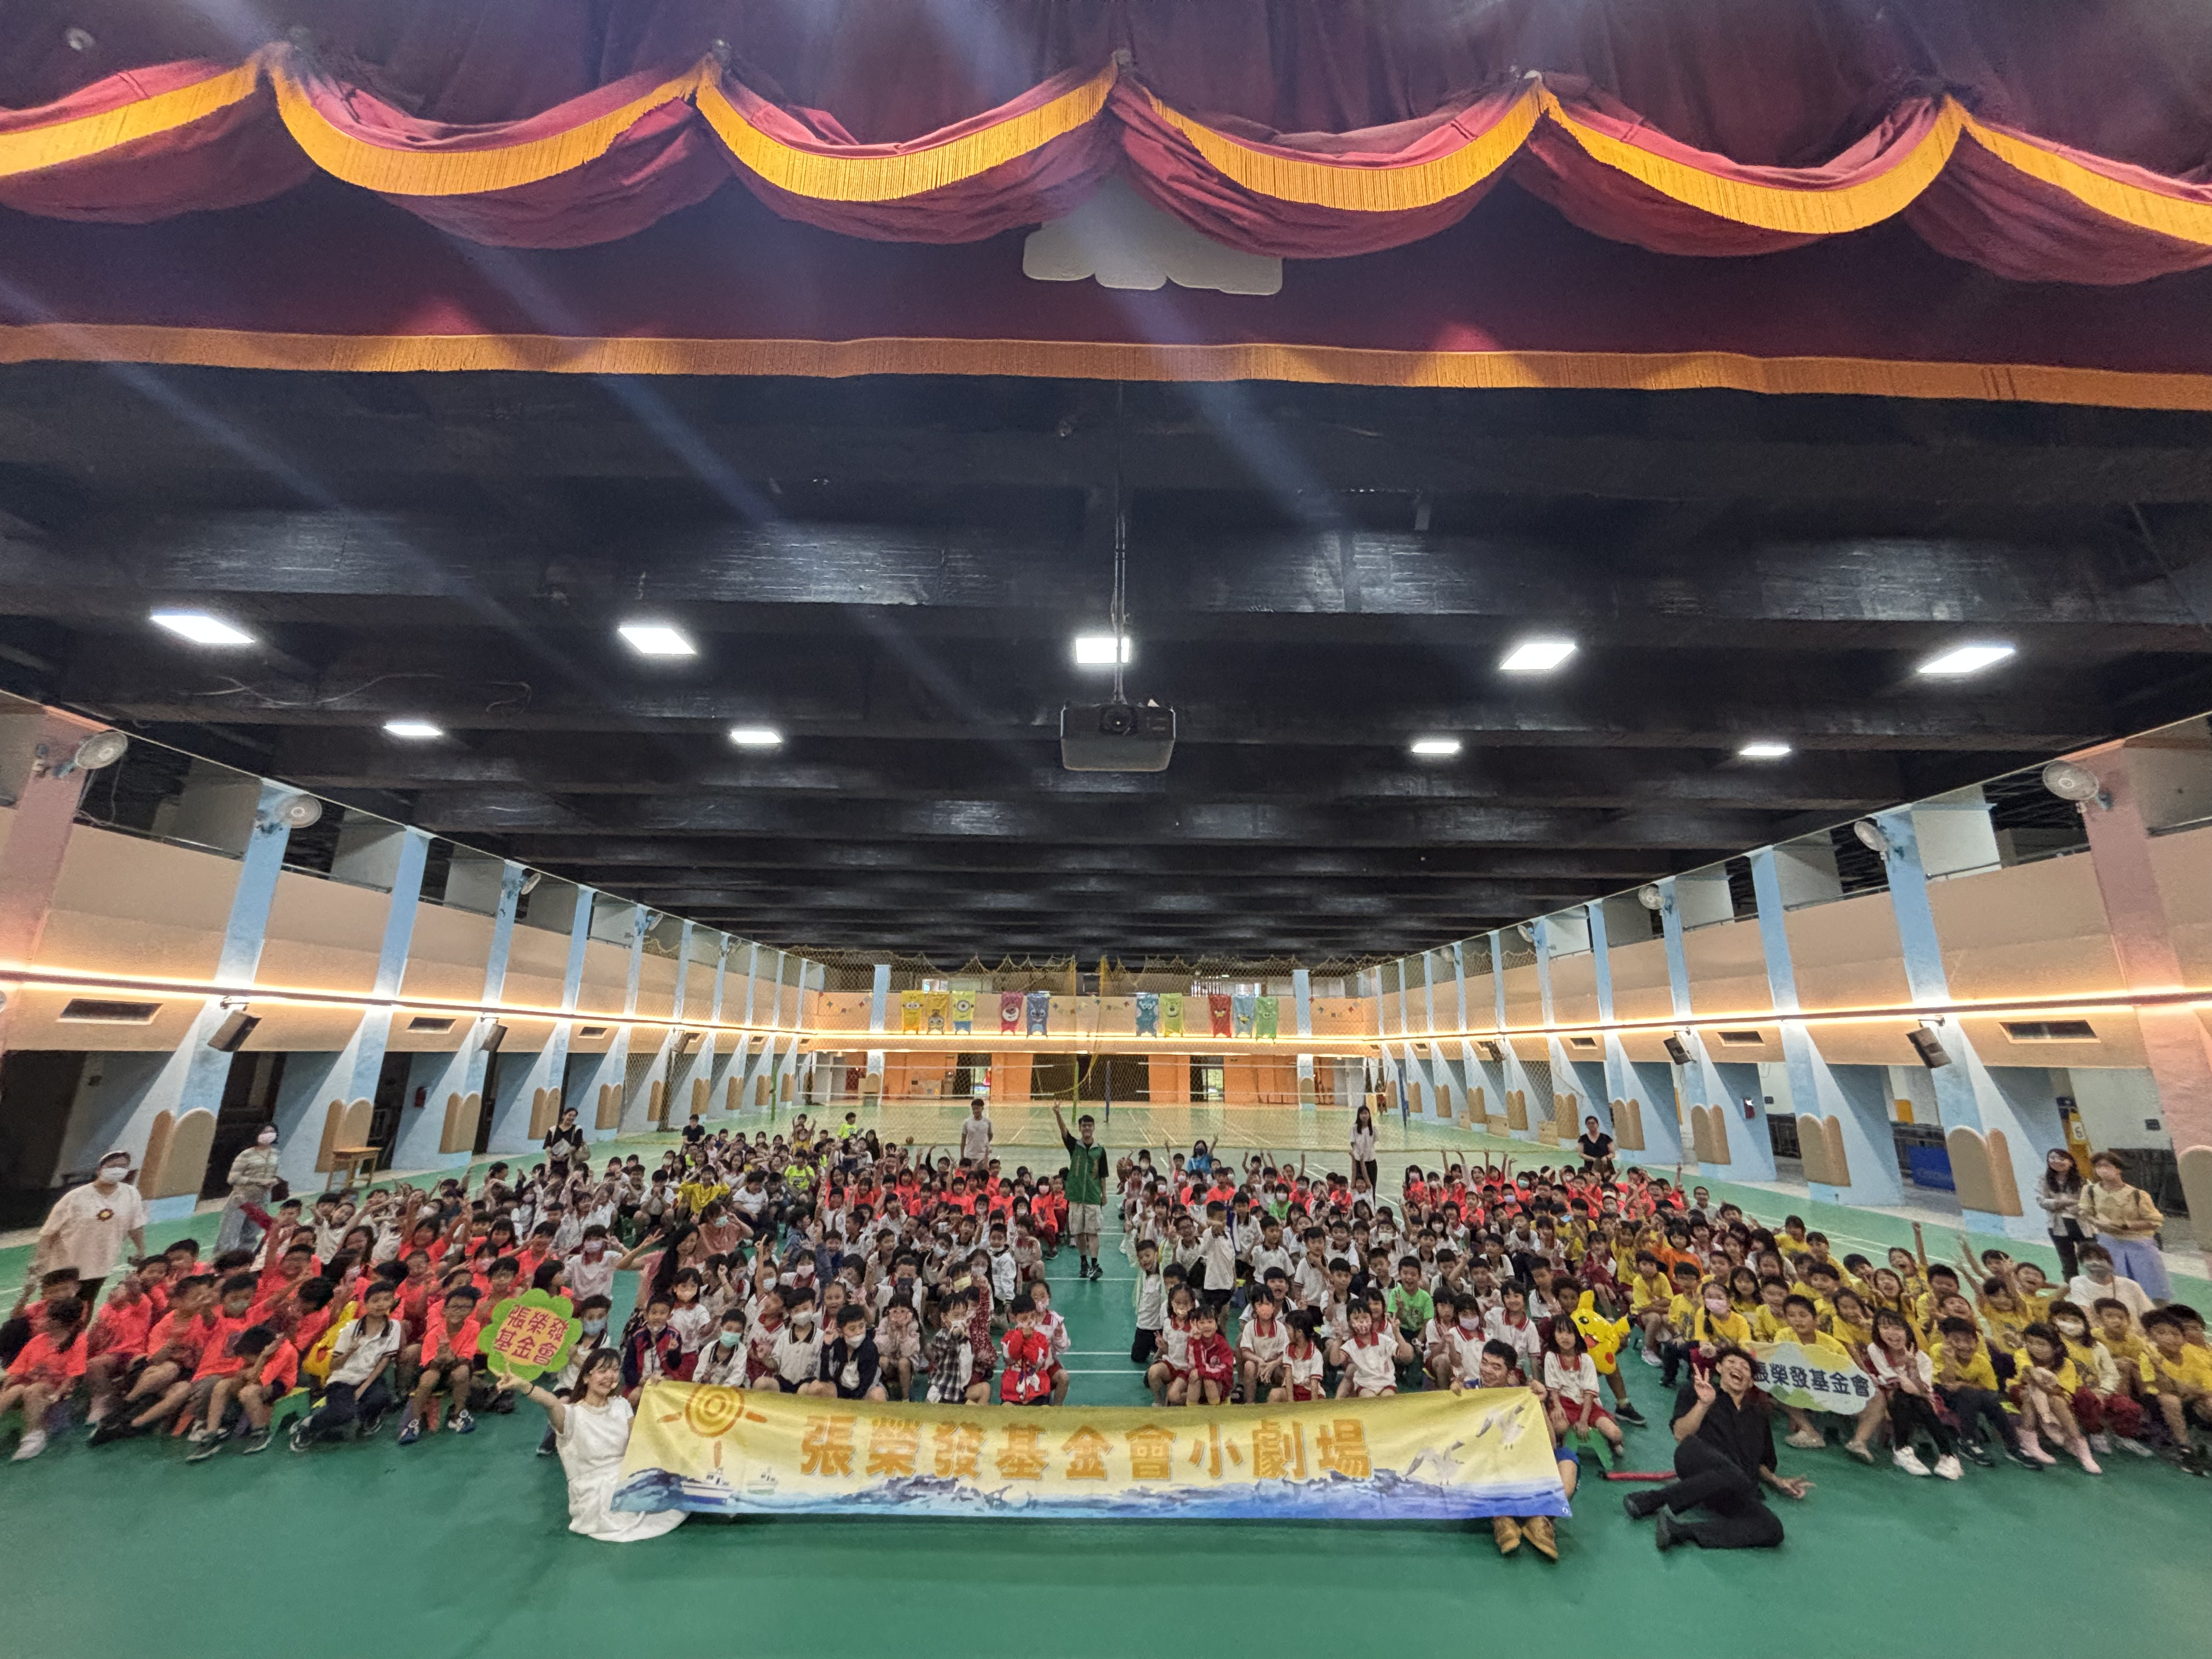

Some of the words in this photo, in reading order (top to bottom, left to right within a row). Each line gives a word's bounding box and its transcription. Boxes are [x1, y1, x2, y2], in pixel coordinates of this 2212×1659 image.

[508, 1304, 569, 1342] 張榮發
[494, 1328, 558, 1366] 基金會
[800, 1415, 1372, 1481] 張榮發基金會小劇場
